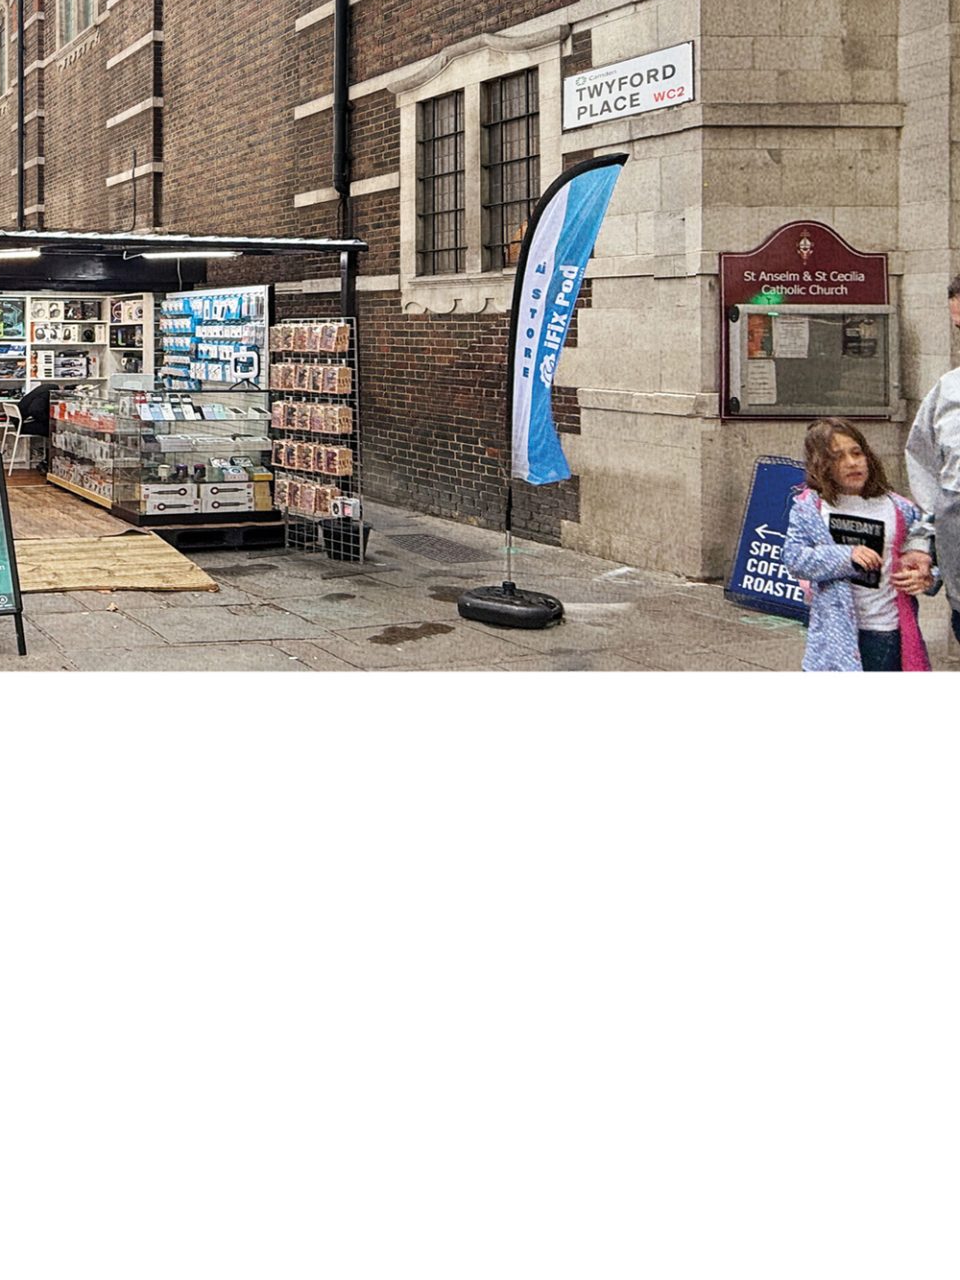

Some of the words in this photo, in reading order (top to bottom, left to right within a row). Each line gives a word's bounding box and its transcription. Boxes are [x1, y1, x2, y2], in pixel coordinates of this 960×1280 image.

[576, 64, 676, 101] TWYFORD
[577, 92, 640, 120] PLACE
[654, 86, 685, 102] WC2
[555, 265, 579, 308] Pod
[744, 271, 756, 281] St
[759, 271, 799, 281] Anselm
[803, 271, 812, 281] &
[815, 271, 827, 281] St
[830, 271, 865, 281] Cecilia
[762, 285, 806, 295] Catholic
[809, 285, 848, 295] Church
